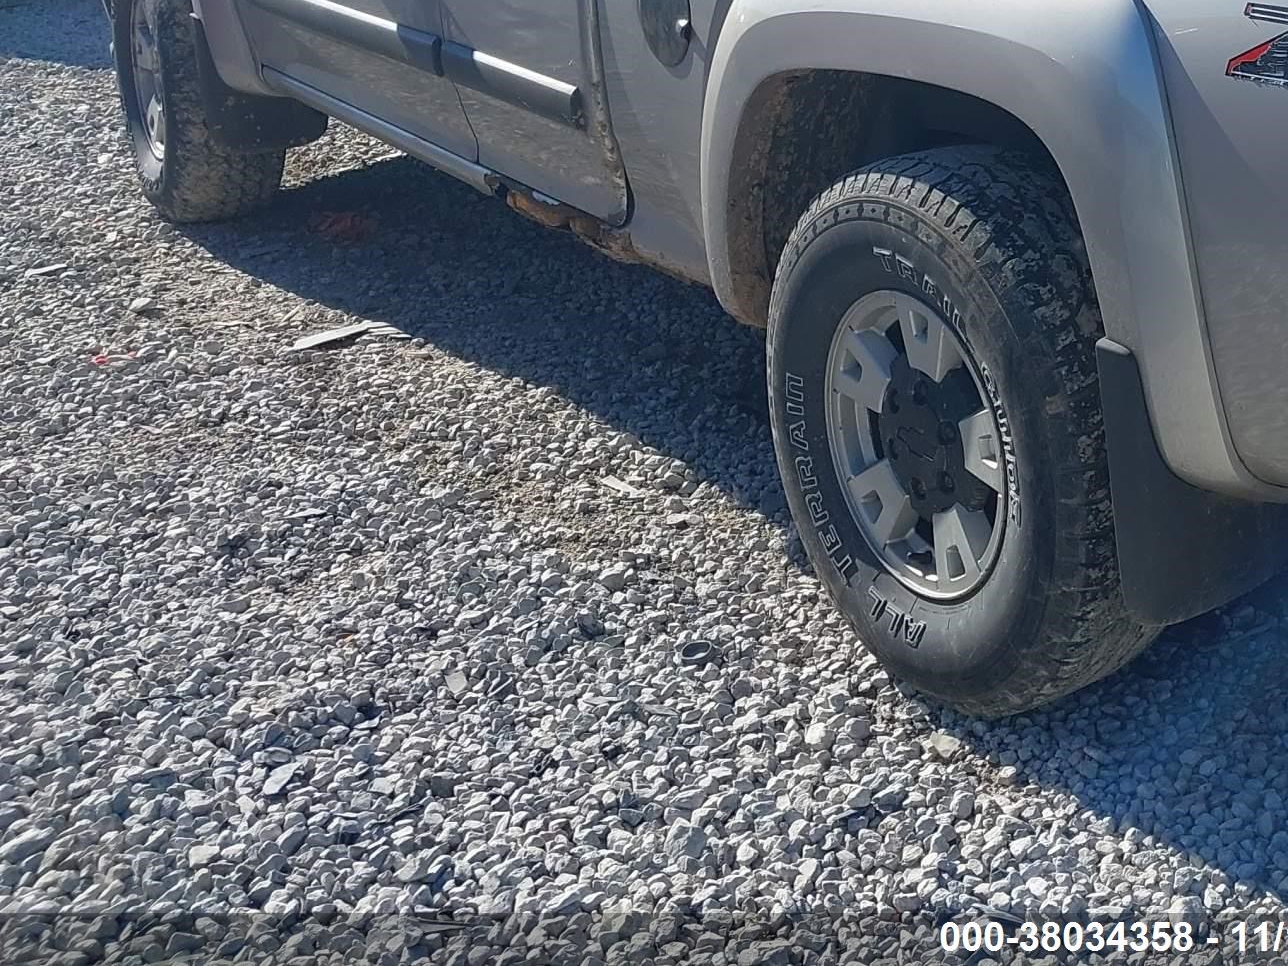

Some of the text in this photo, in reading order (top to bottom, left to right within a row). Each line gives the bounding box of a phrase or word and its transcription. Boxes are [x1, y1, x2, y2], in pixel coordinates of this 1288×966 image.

[872, 246, 976, 354] TRAIL
[785, 373, 928, 650] ALL TERRAIN
